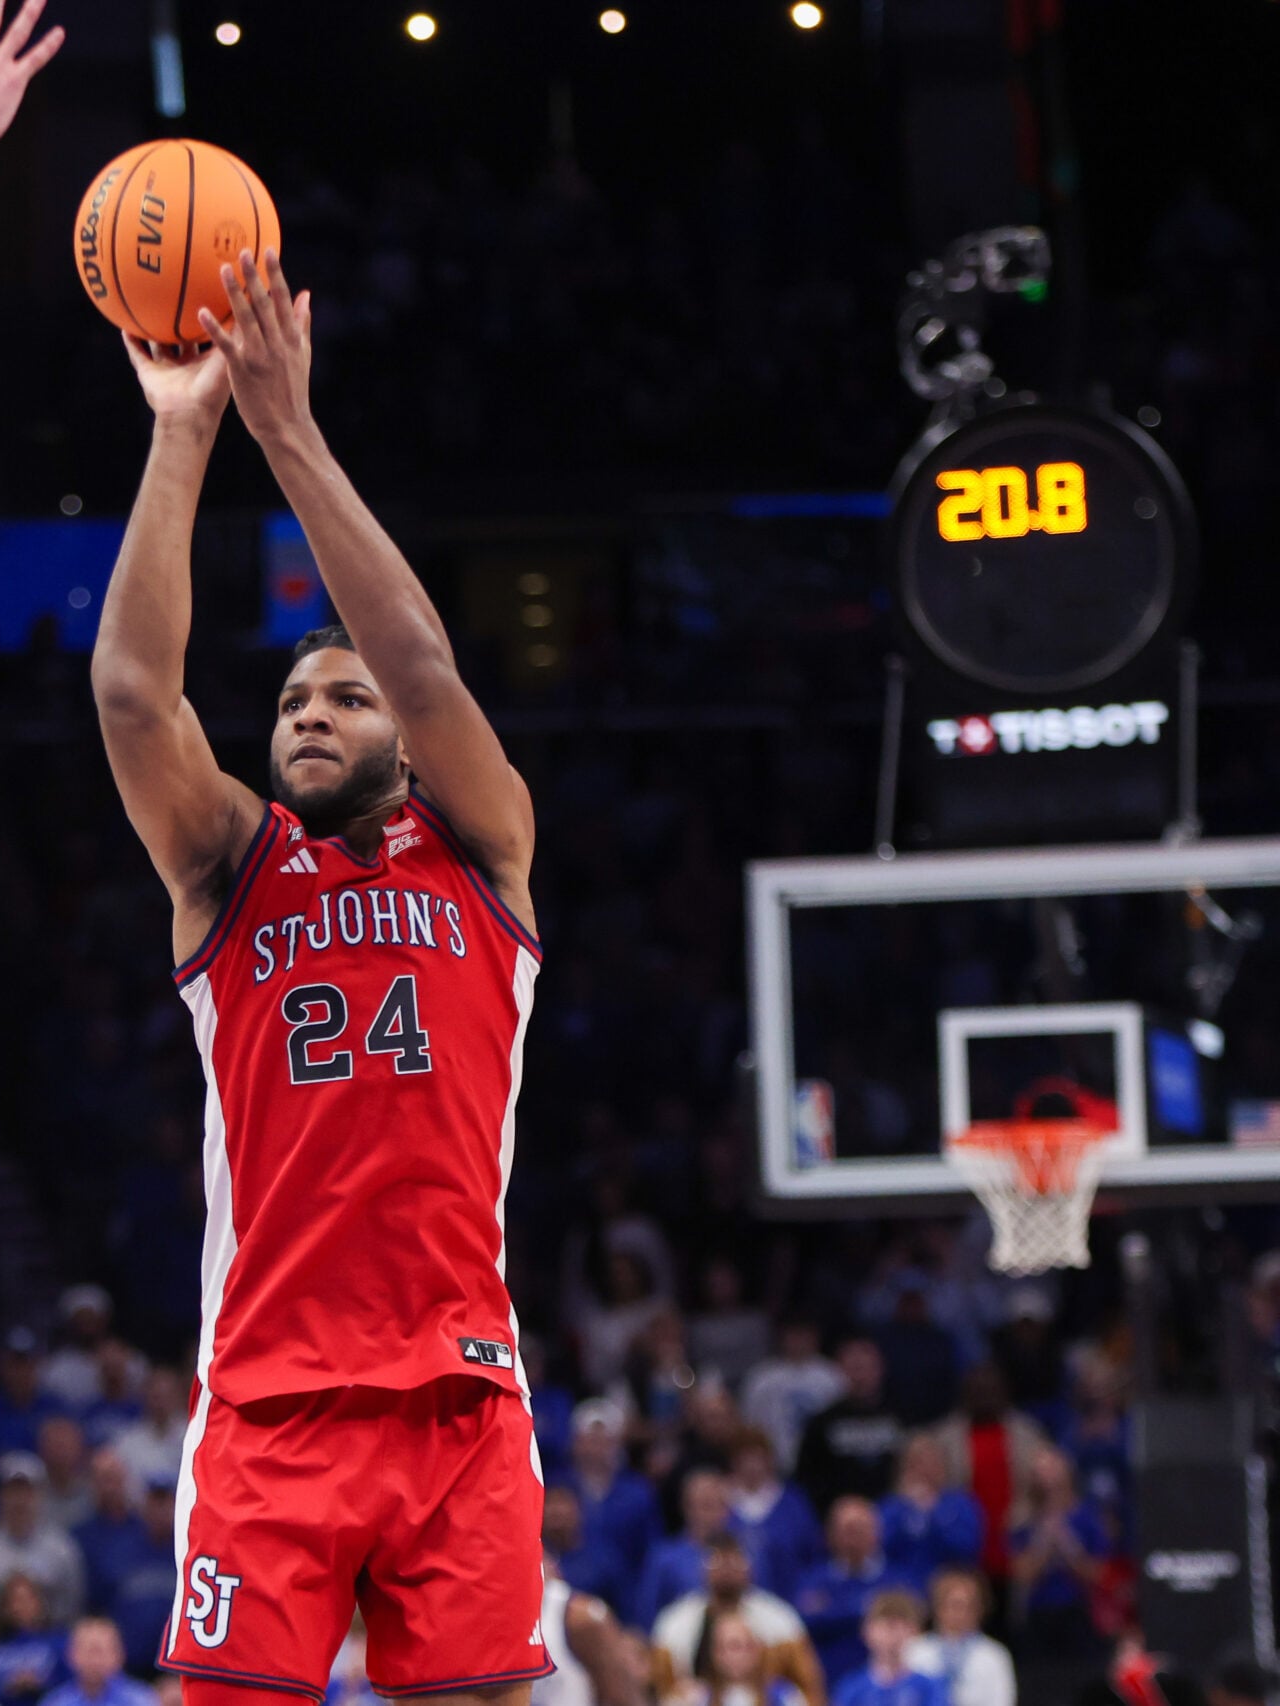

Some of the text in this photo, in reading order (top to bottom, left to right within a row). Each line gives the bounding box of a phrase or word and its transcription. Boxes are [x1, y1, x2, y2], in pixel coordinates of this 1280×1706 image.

[136, 194, 167, 276] EVO
[935, 461, 1088, 542] 20.8
[991, 701, 1169, 754] TISSOT
[281, 974, 433, 1085] 24
